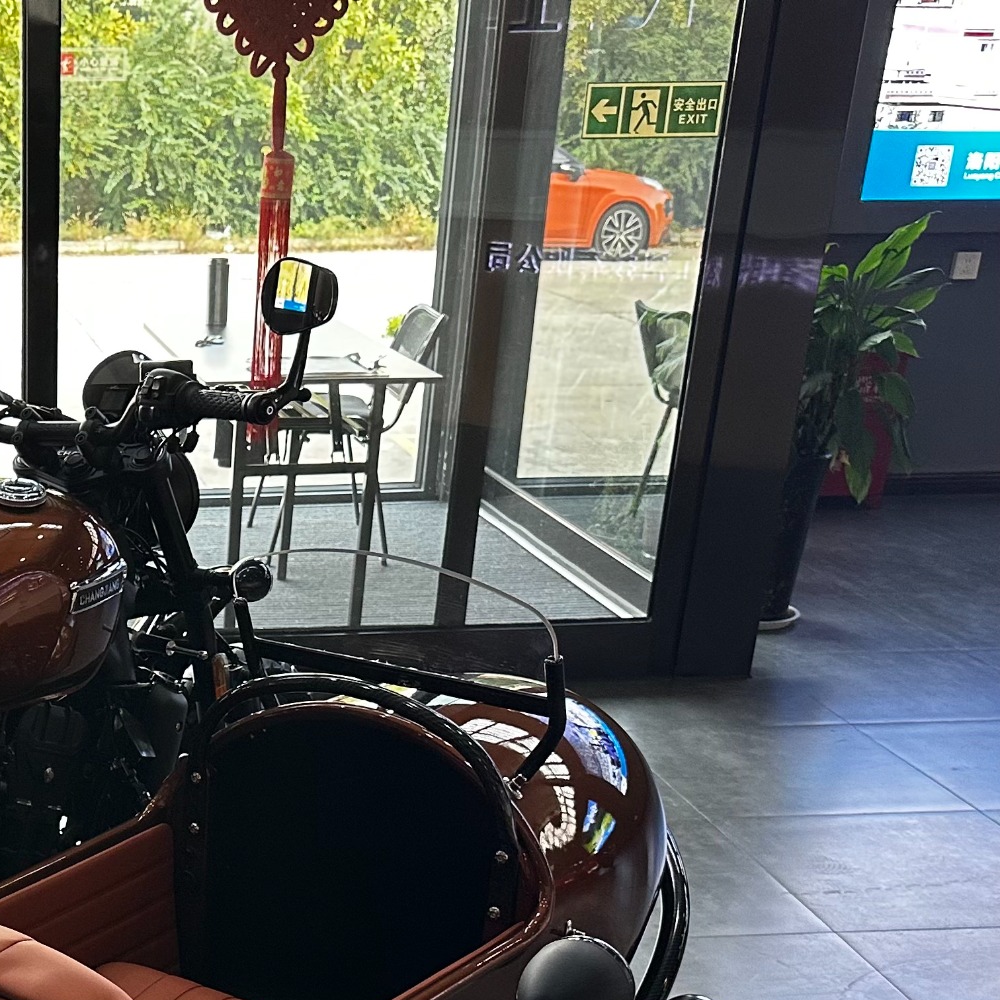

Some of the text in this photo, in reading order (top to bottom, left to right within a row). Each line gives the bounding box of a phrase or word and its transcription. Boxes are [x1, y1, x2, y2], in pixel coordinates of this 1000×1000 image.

[673, 97, 718, 112] 安全出口
[678, 113, 709, 125] EXIT
